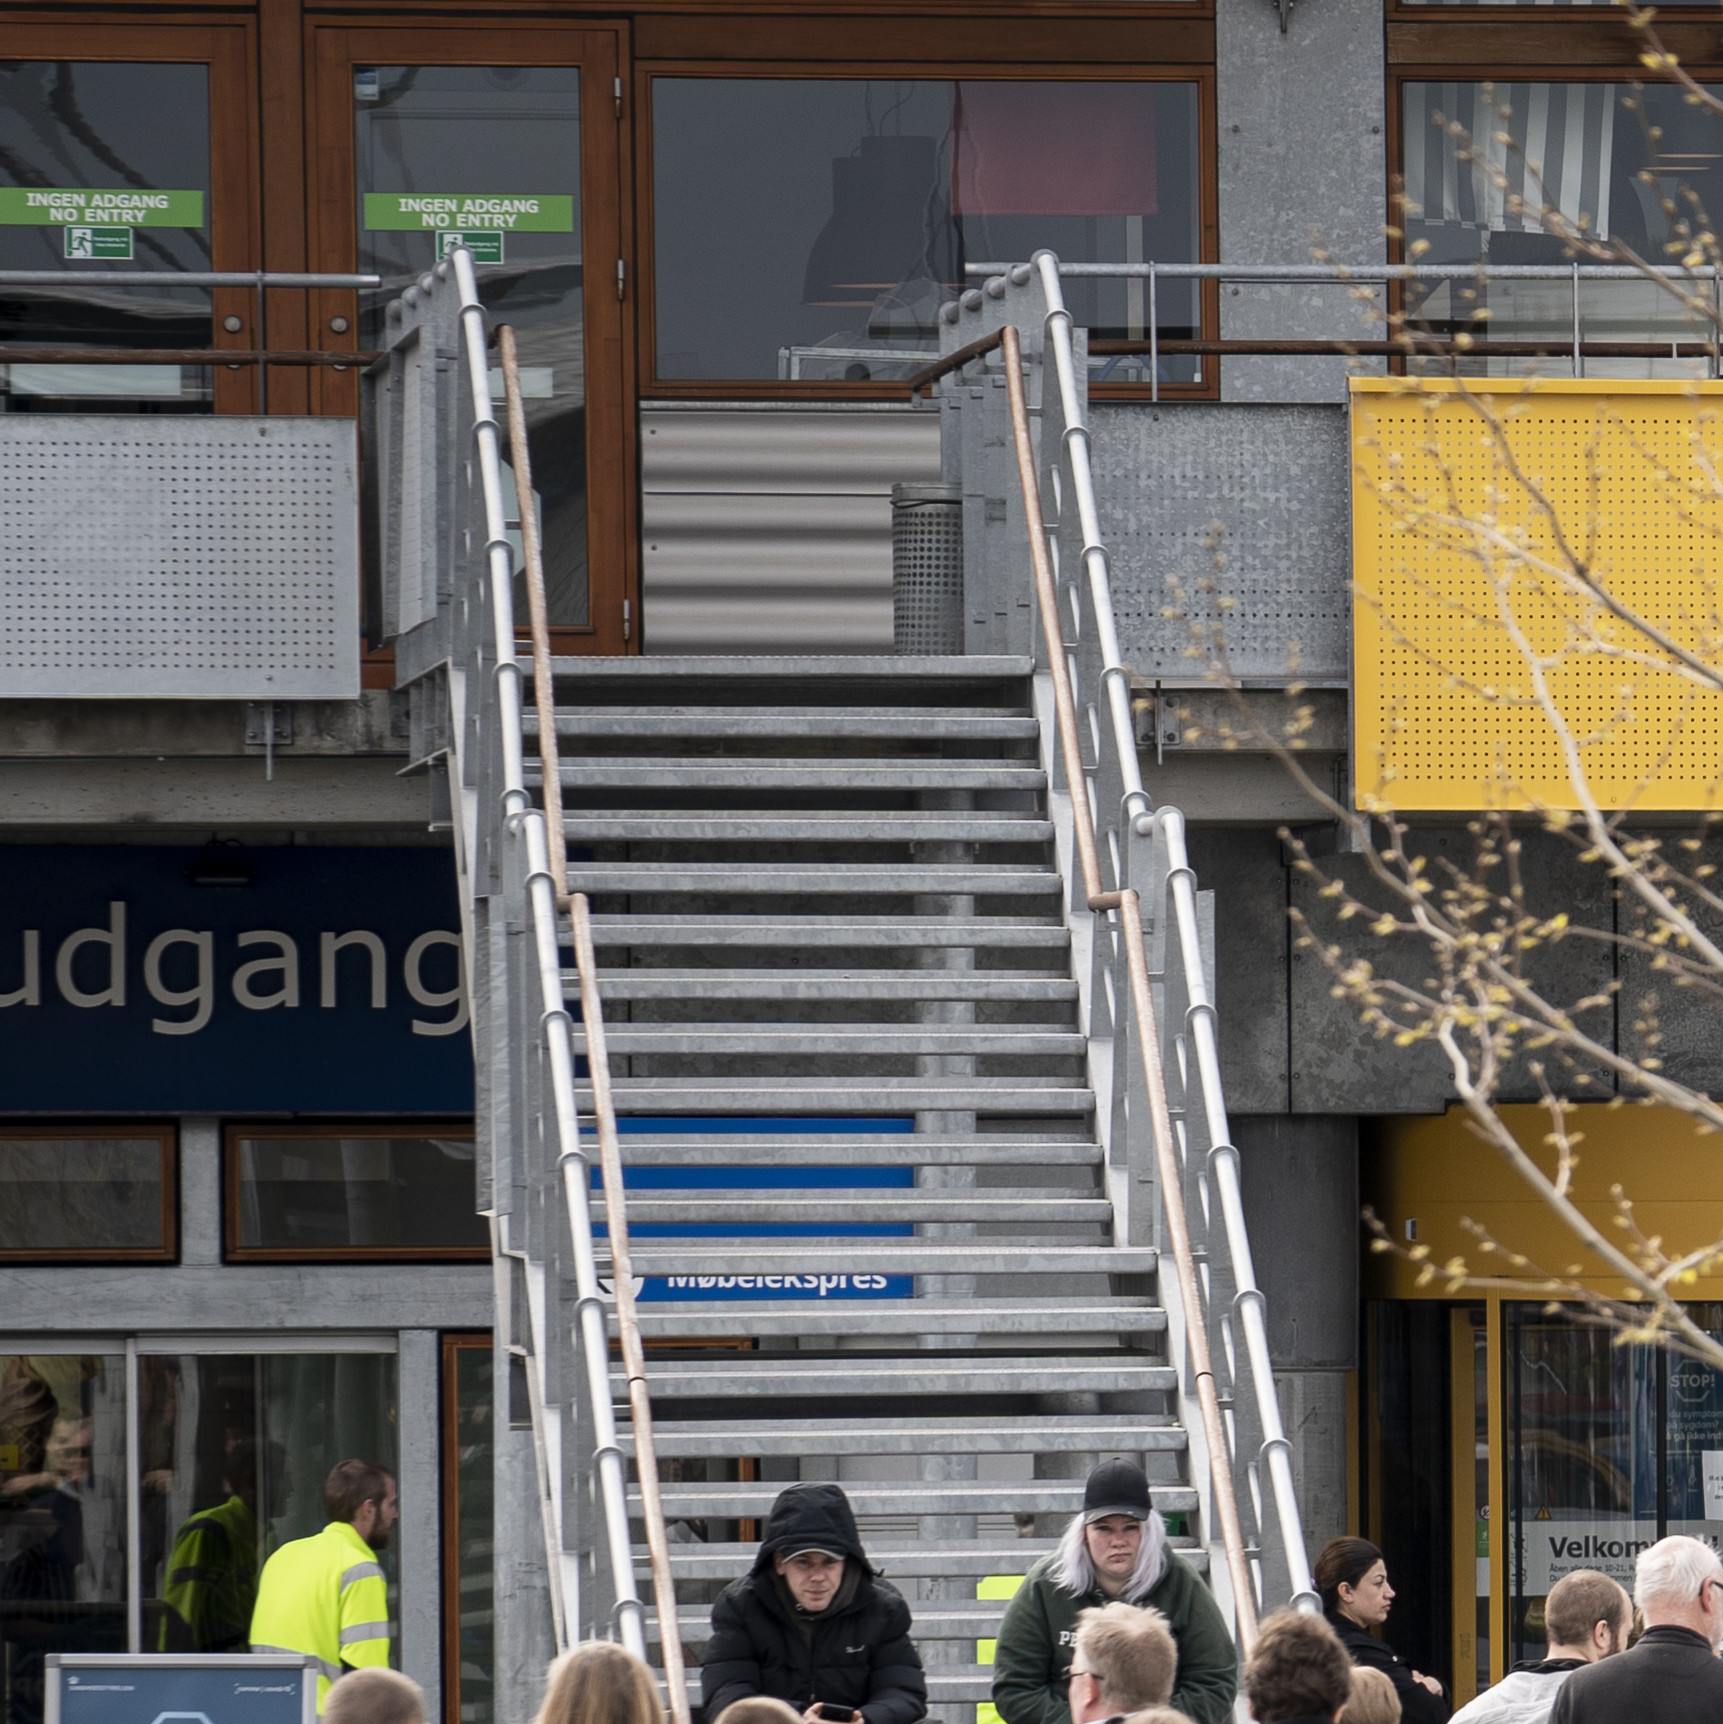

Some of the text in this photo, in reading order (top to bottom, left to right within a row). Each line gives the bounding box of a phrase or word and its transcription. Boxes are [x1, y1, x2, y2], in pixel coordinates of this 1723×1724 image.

[26, 193, 170, 209] INGEN ADGANG
[398, 198, 540, 214] INGEN ADGANG
[50, 208, 147, 222] NO ENTRY
[422, 214, 518, 227] NO ENTRY
[0, 901, 471, 1036] udgang
[1671, 1374, 1716, 1388] STOP!
